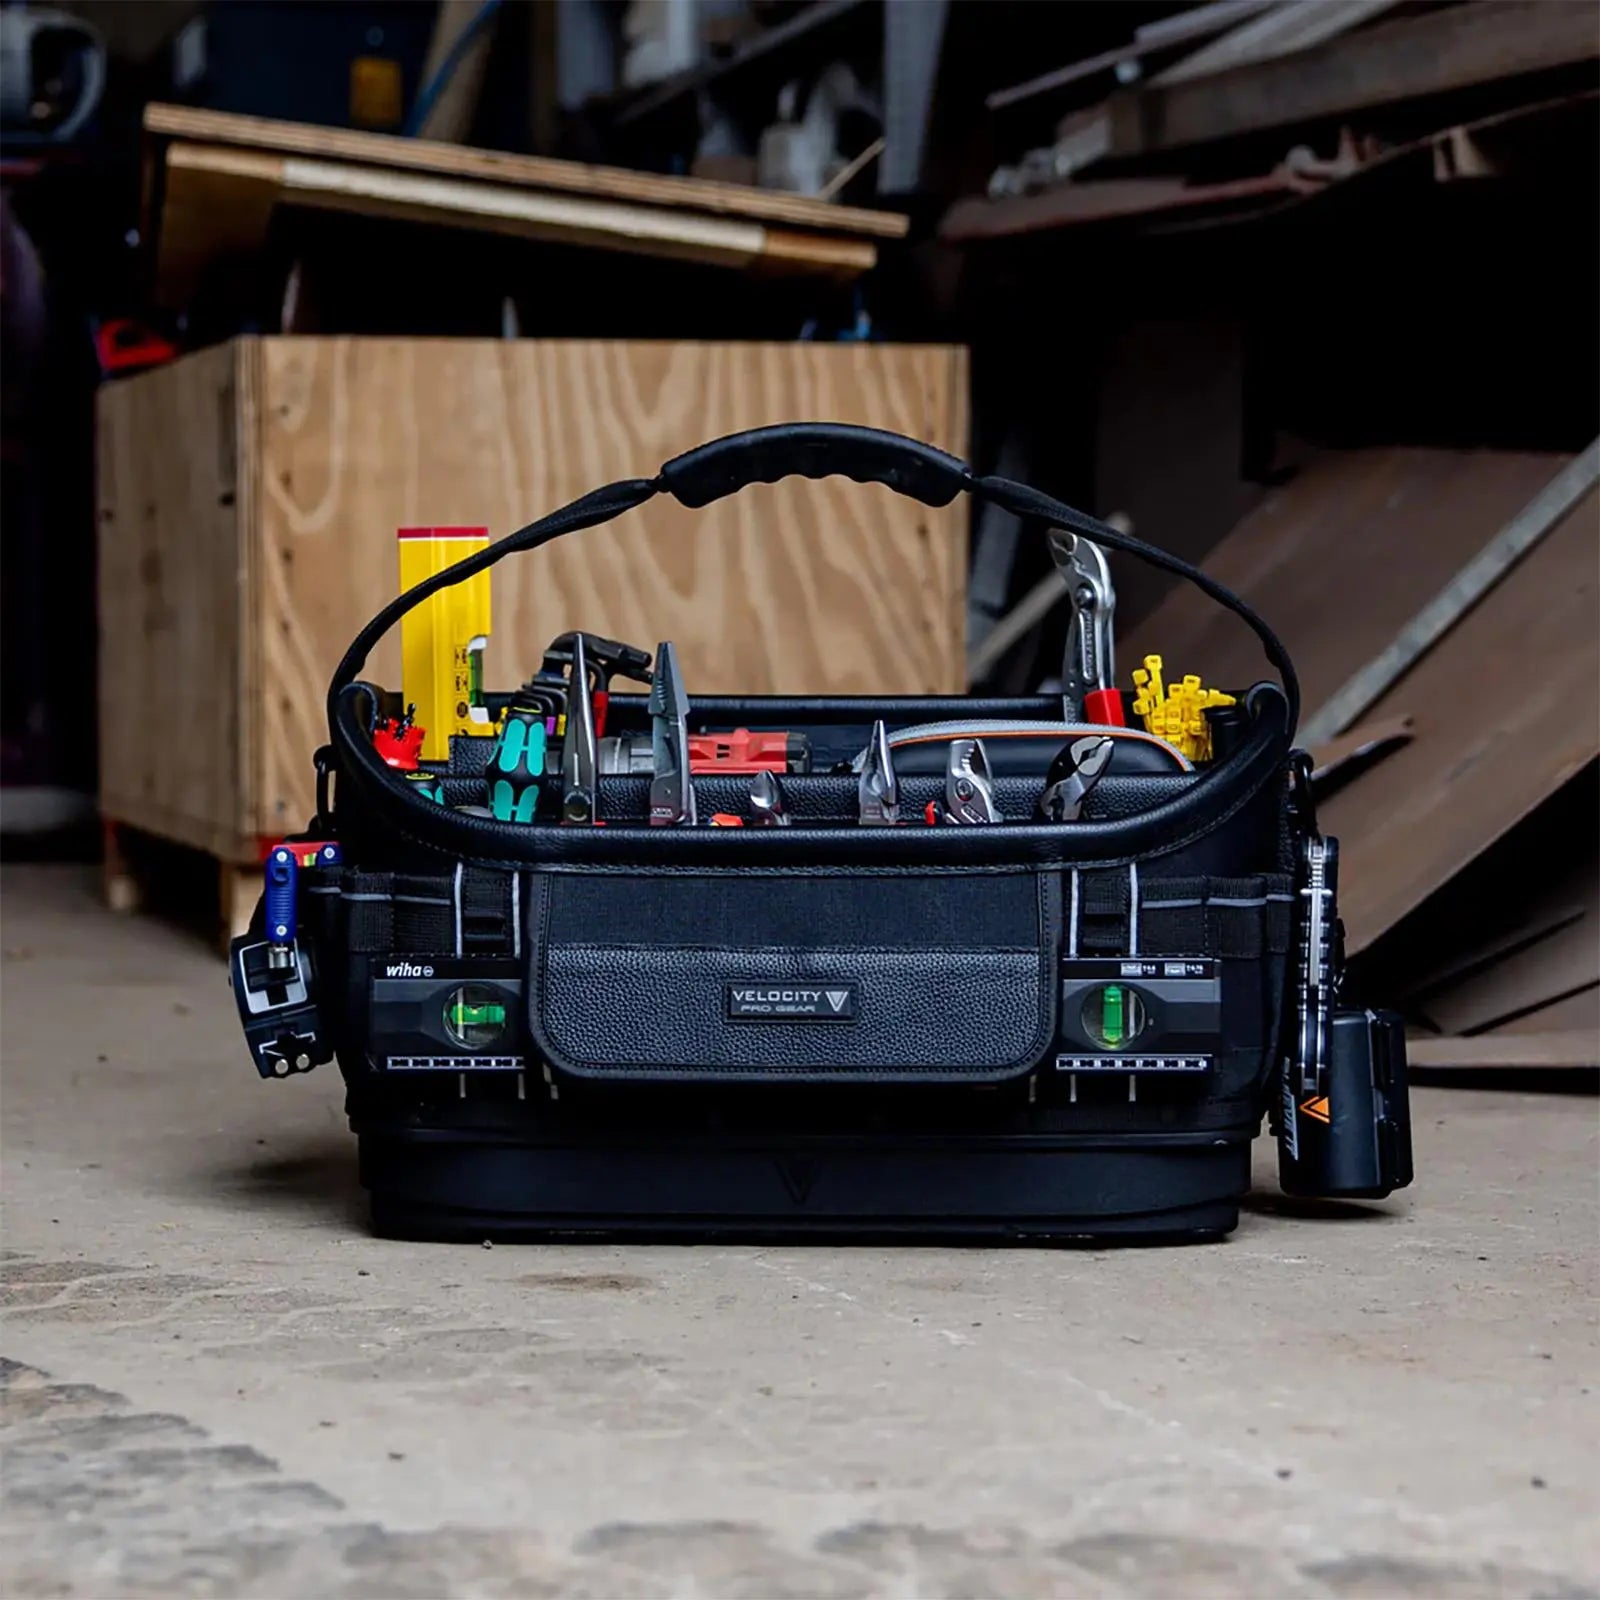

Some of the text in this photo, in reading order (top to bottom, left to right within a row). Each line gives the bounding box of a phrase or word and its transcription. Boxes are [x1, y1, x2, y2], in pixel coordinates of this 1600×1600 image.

[386, 961, 422, 977] wiha
[732, 990, 822, 1002] VELOCITY
[740, 1004, 816, 1013] PRO GEAR
